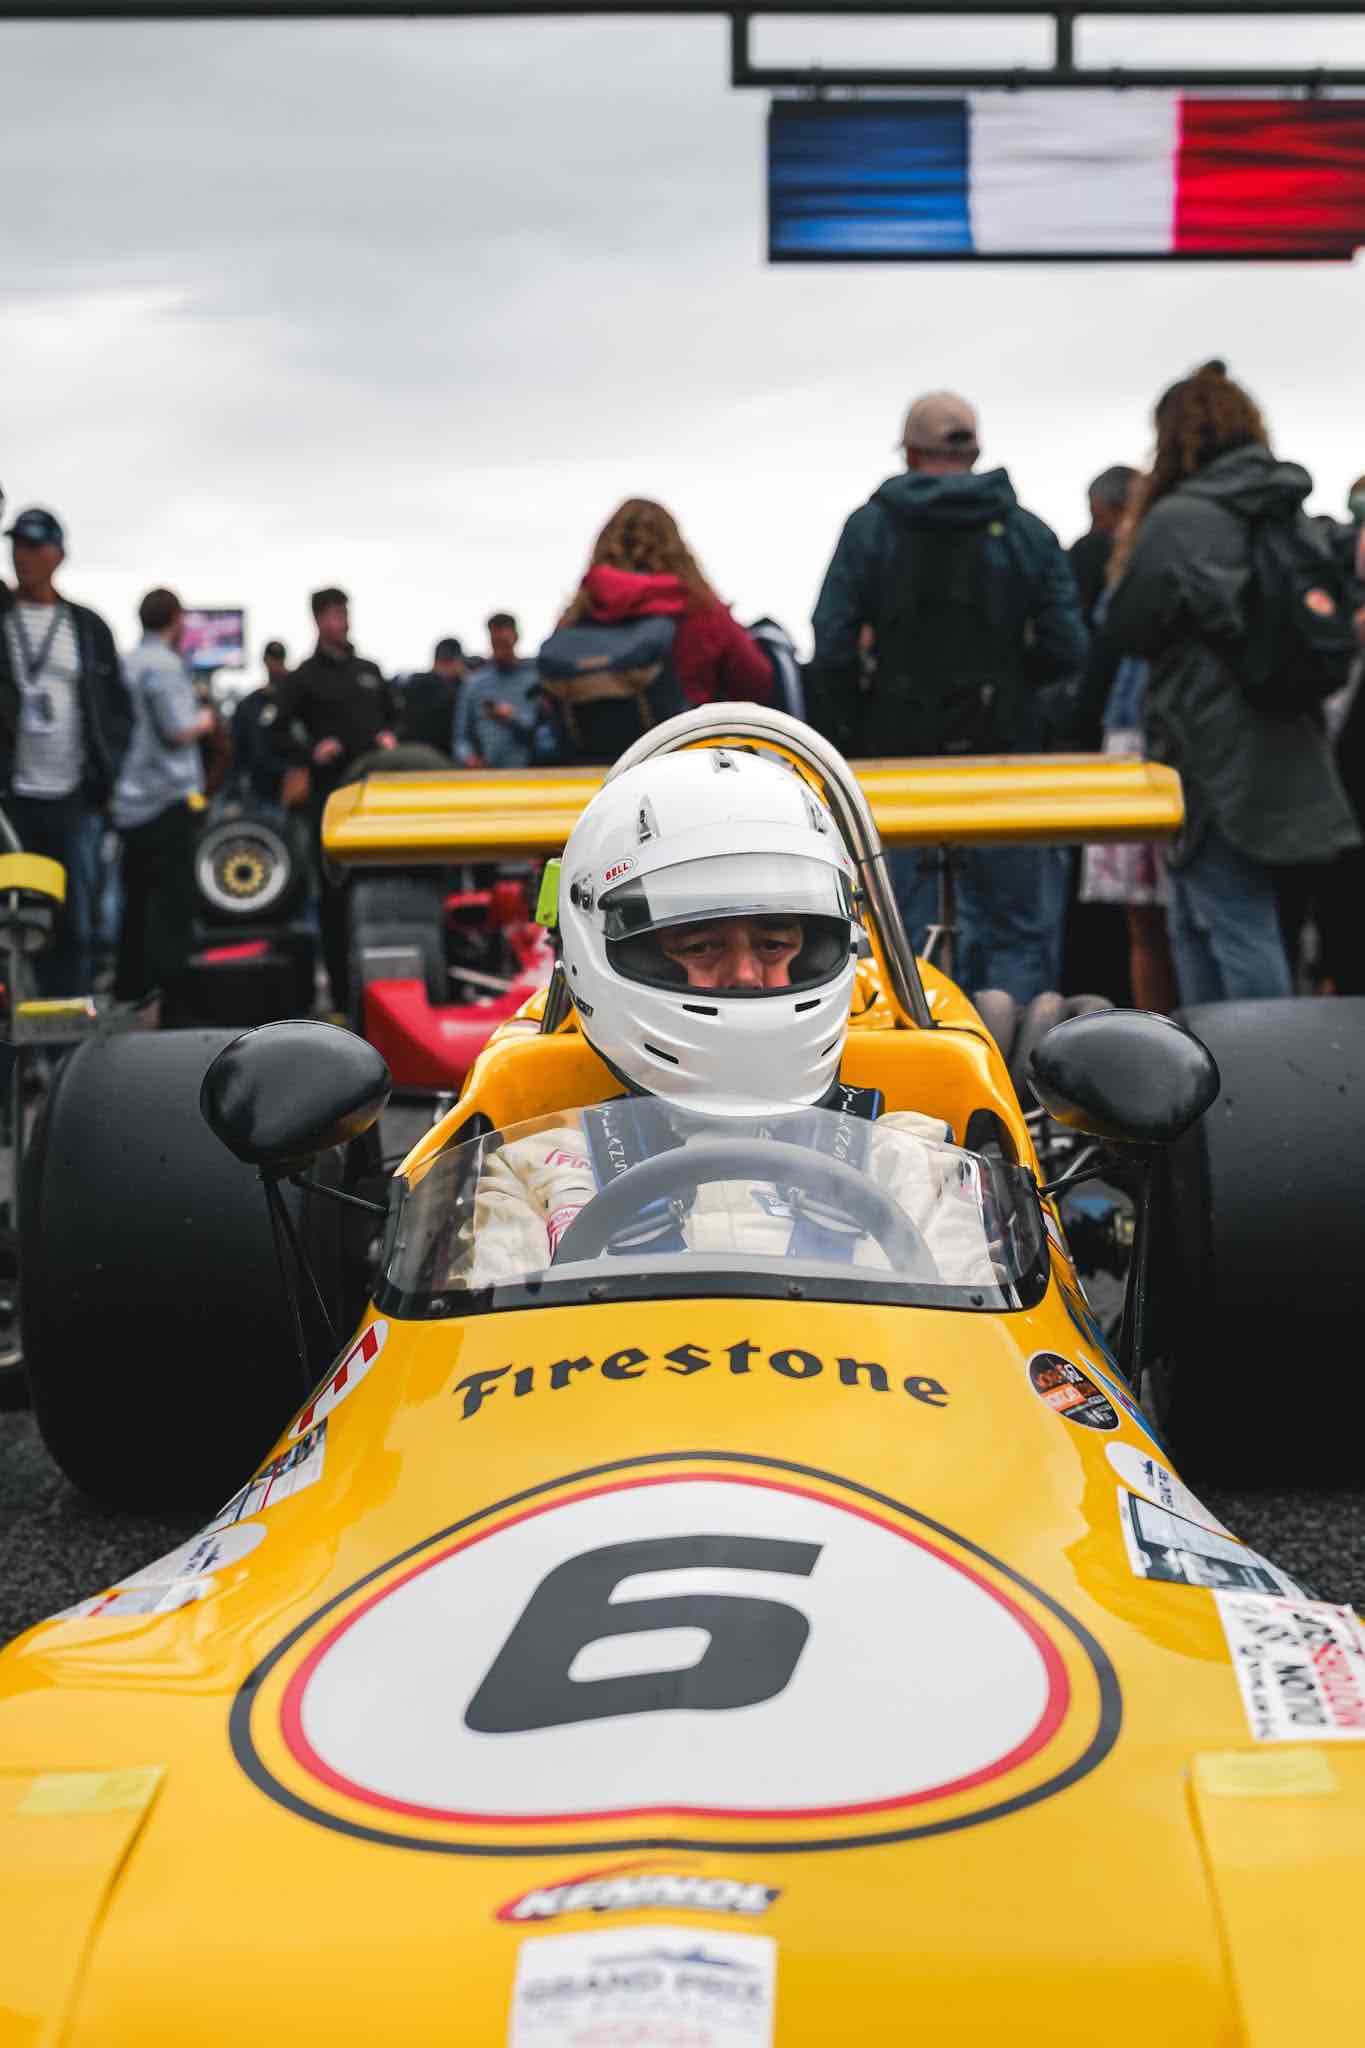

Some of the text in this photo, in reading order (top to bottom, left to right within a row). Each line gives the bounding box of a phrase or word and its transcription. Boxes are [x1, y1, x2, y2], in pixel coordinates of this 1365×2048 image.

[605, 862, 629, 881] BELL
[453, 1339, 950, 1420] Firestone
[463, 1534, 825, 1734] 6
